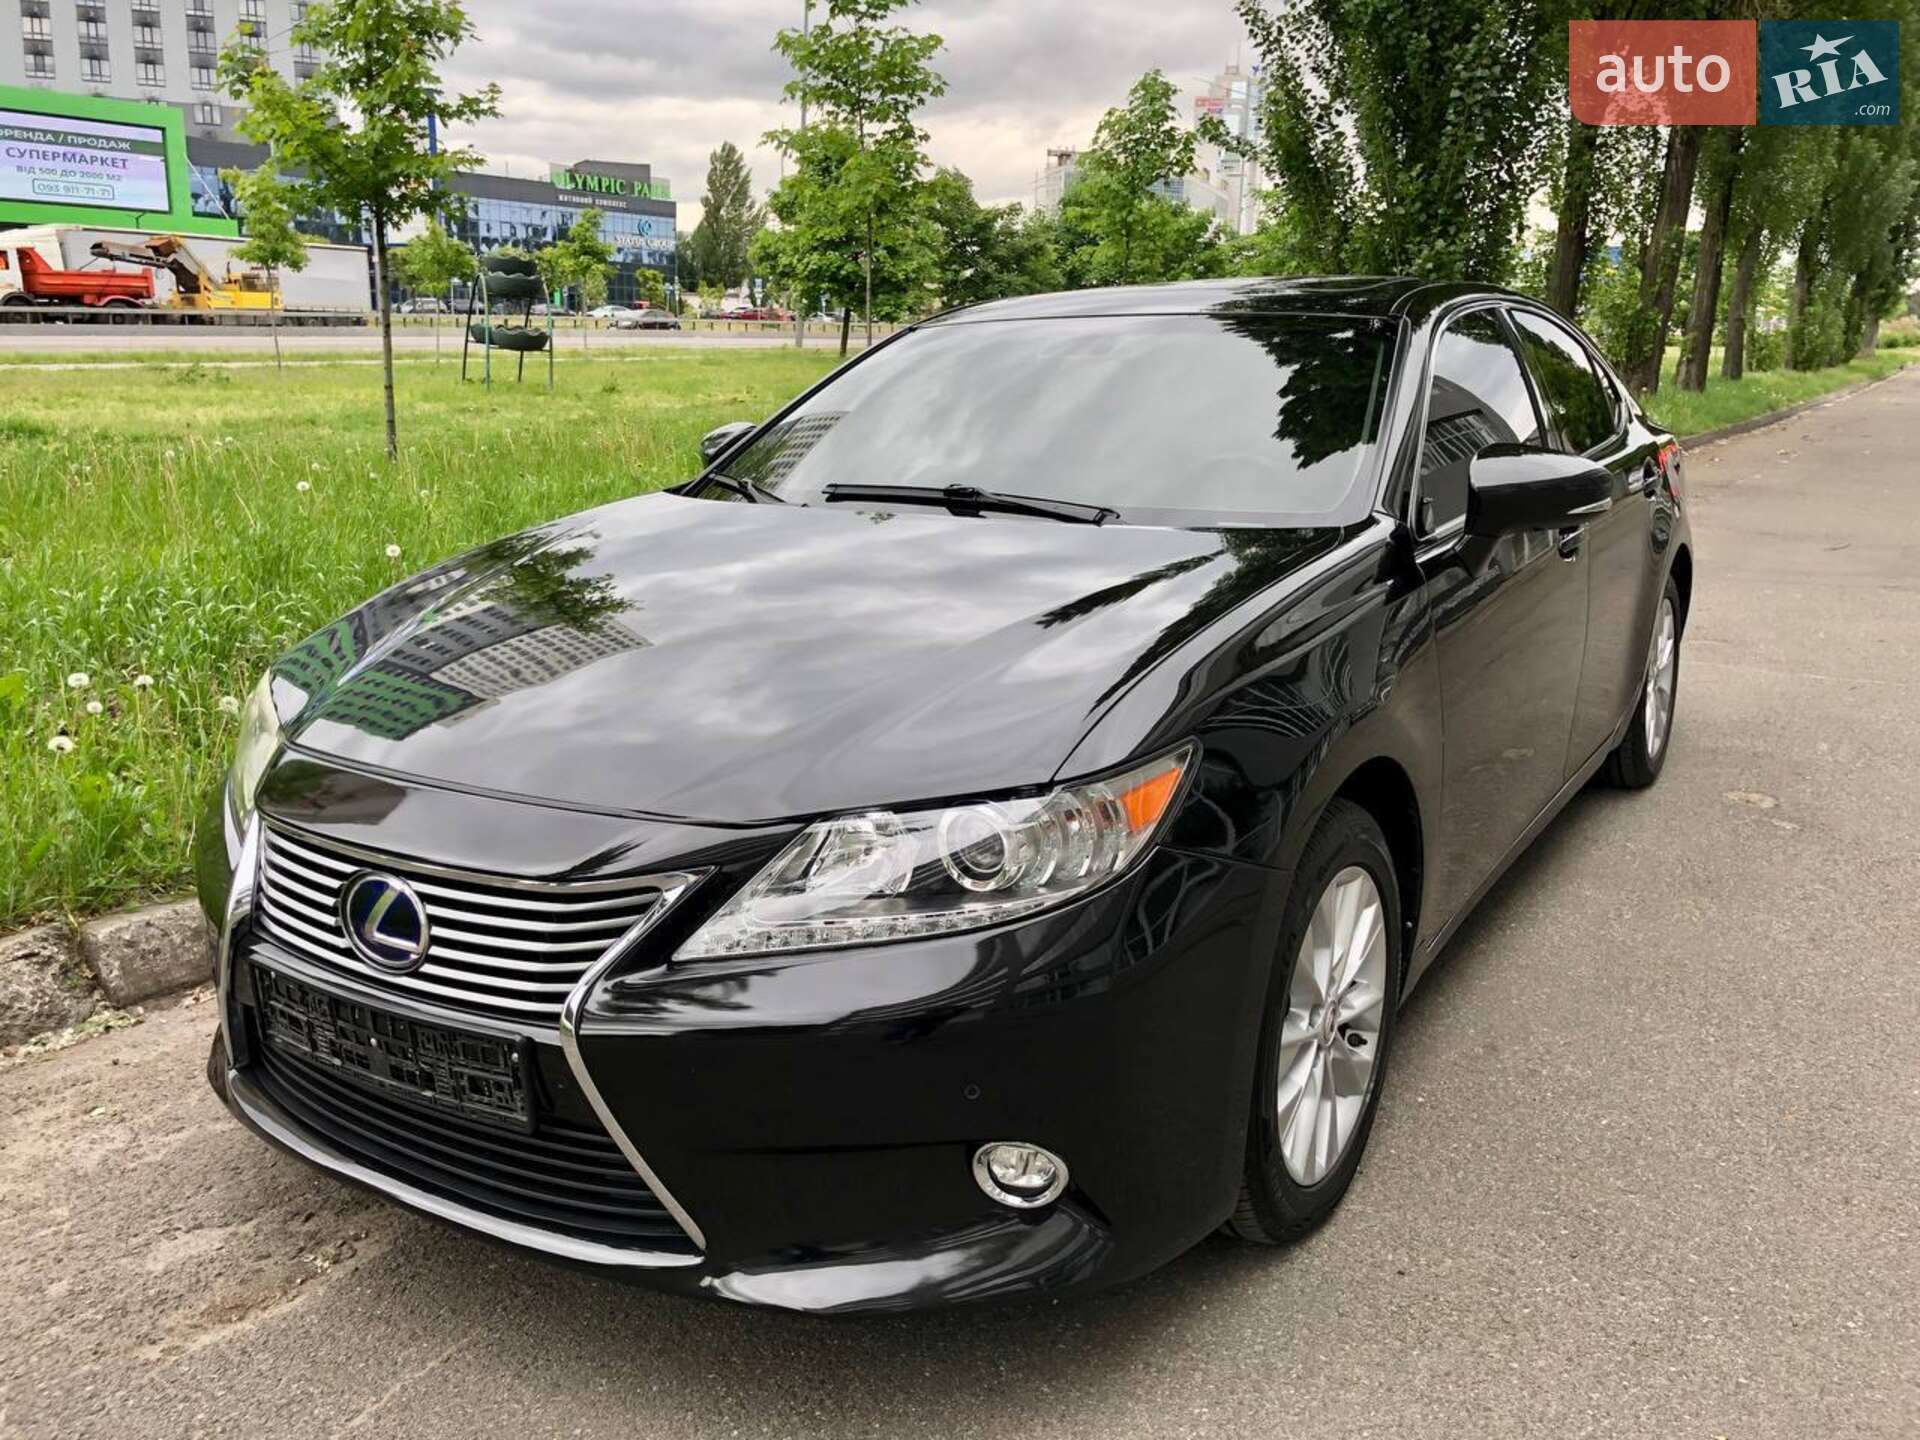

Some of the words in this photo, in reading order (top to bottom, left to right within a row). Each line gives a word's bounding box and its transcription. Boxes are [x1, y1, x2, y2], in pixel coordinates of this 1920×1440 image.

[67, 135, 131, 150] ПРОДАЖ
[5, 146, 129, 169] СУПЕРМАРКЕТ
[60, 169, 76, 178] ДО
